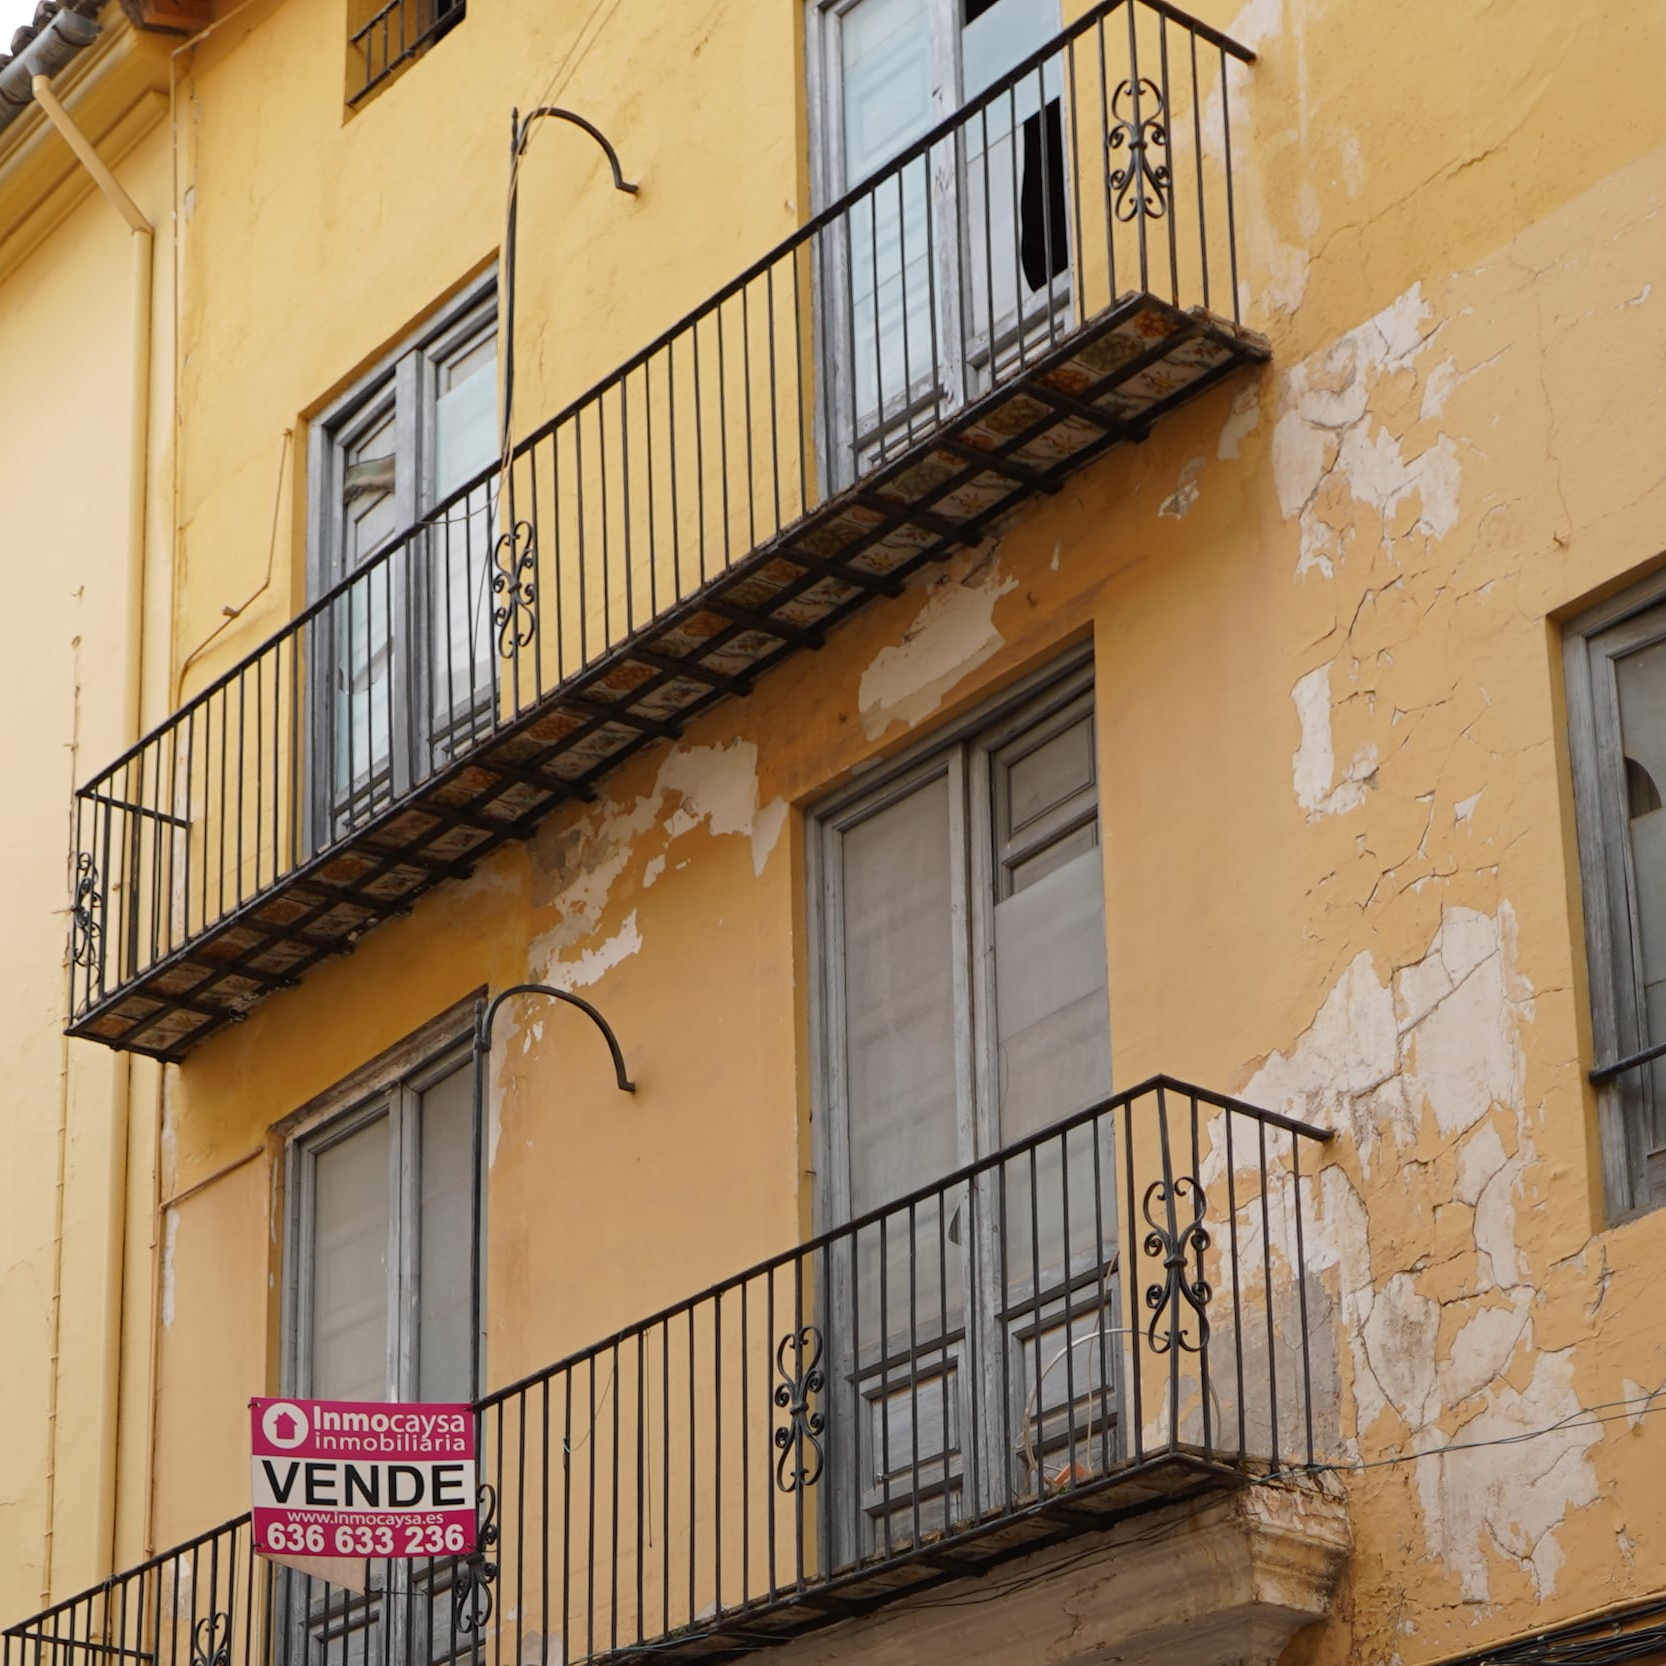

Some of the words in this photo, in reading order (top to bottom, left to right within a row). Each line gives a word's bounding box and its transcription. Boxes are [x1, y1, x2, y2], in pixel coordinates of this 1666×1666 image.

[313, 1405, 466, 1438] Inmocaysa
[315, 1432, 466, 1452] inmobiliaria
[261, 1459, 466, 1508] VENDE
[287, 1511, 444, 1529] www.inmocaysa.es
[267, 1521, 325, 1552] 636
[335, 1526, 395, 1554] 633
[404, 1523, 465, 1554] 236
